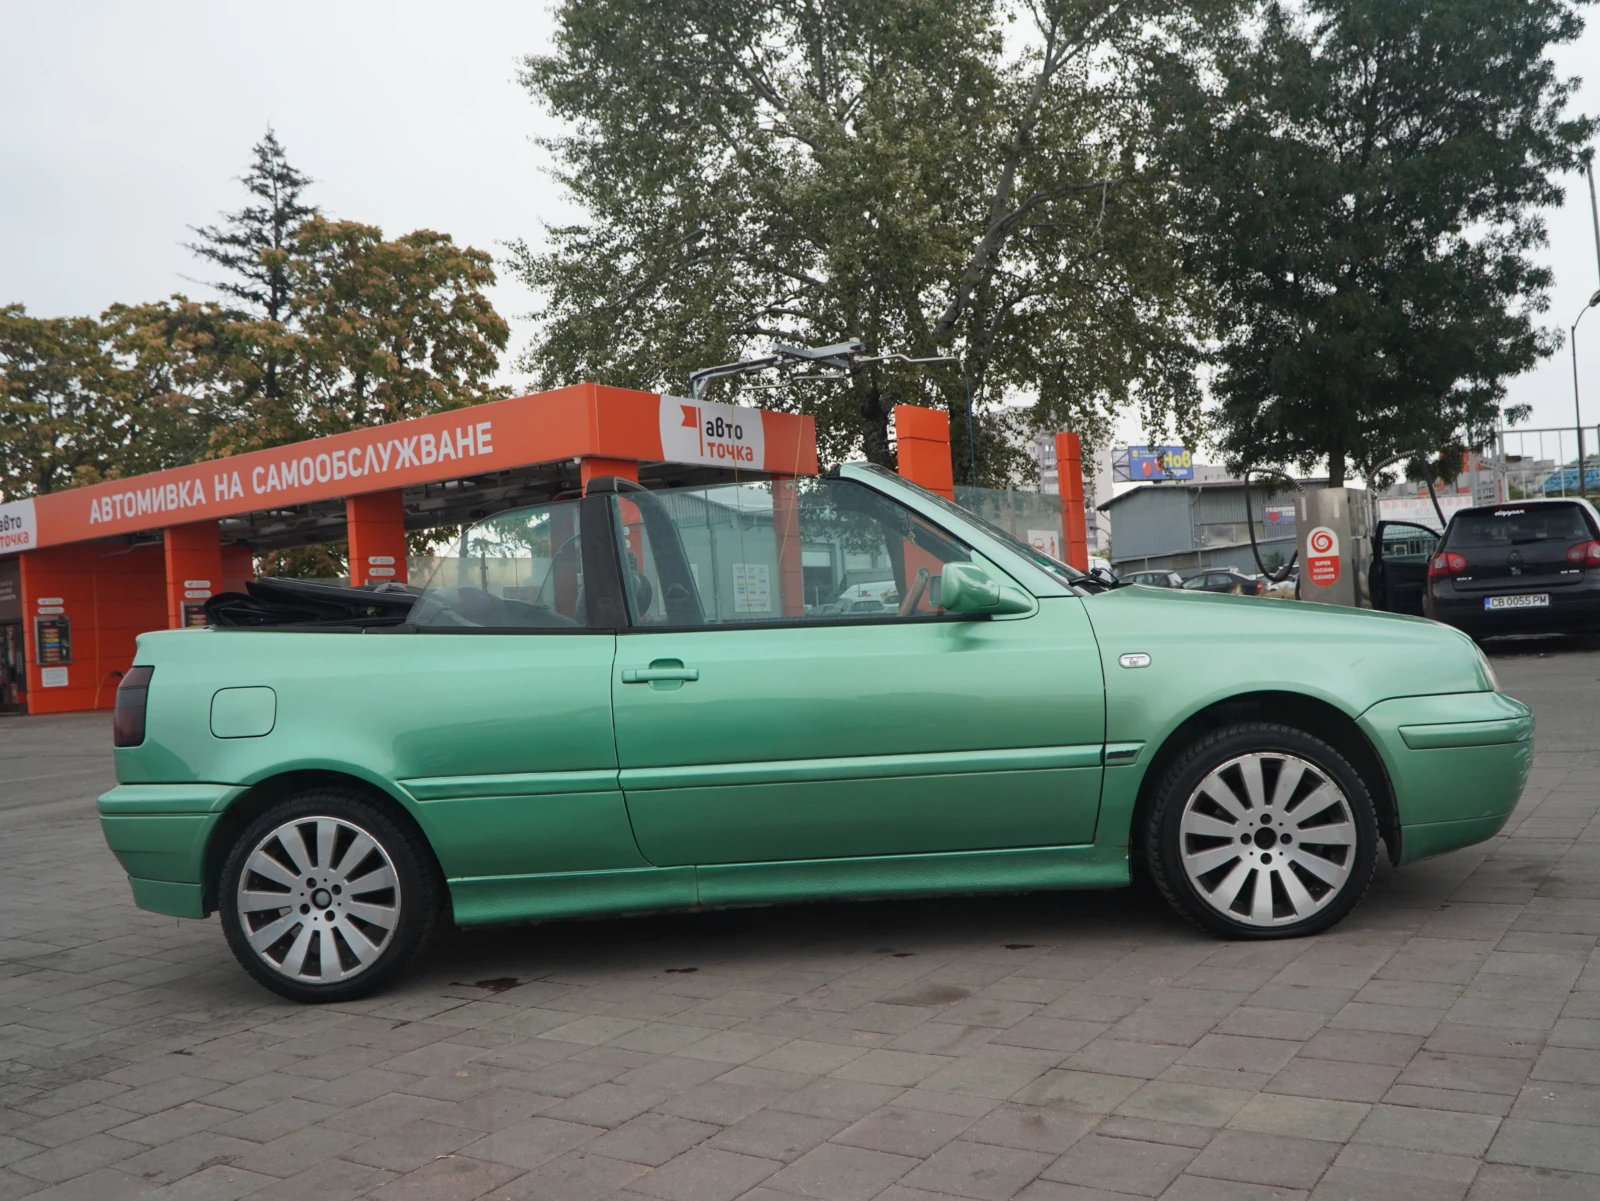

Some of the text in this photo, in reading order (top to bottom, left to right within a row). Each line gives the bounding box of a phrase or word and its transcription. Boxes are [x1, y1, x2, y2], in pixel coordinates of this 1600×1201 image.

[706, 416, 743, 440] авто
[707, 442, 754, 462] точка
[90, 421, 494, 525] АВТОМИВКА НА САМООБСЛУЖВАНЕ
[1491, 595, 1547, 608] CB 0055 PM
